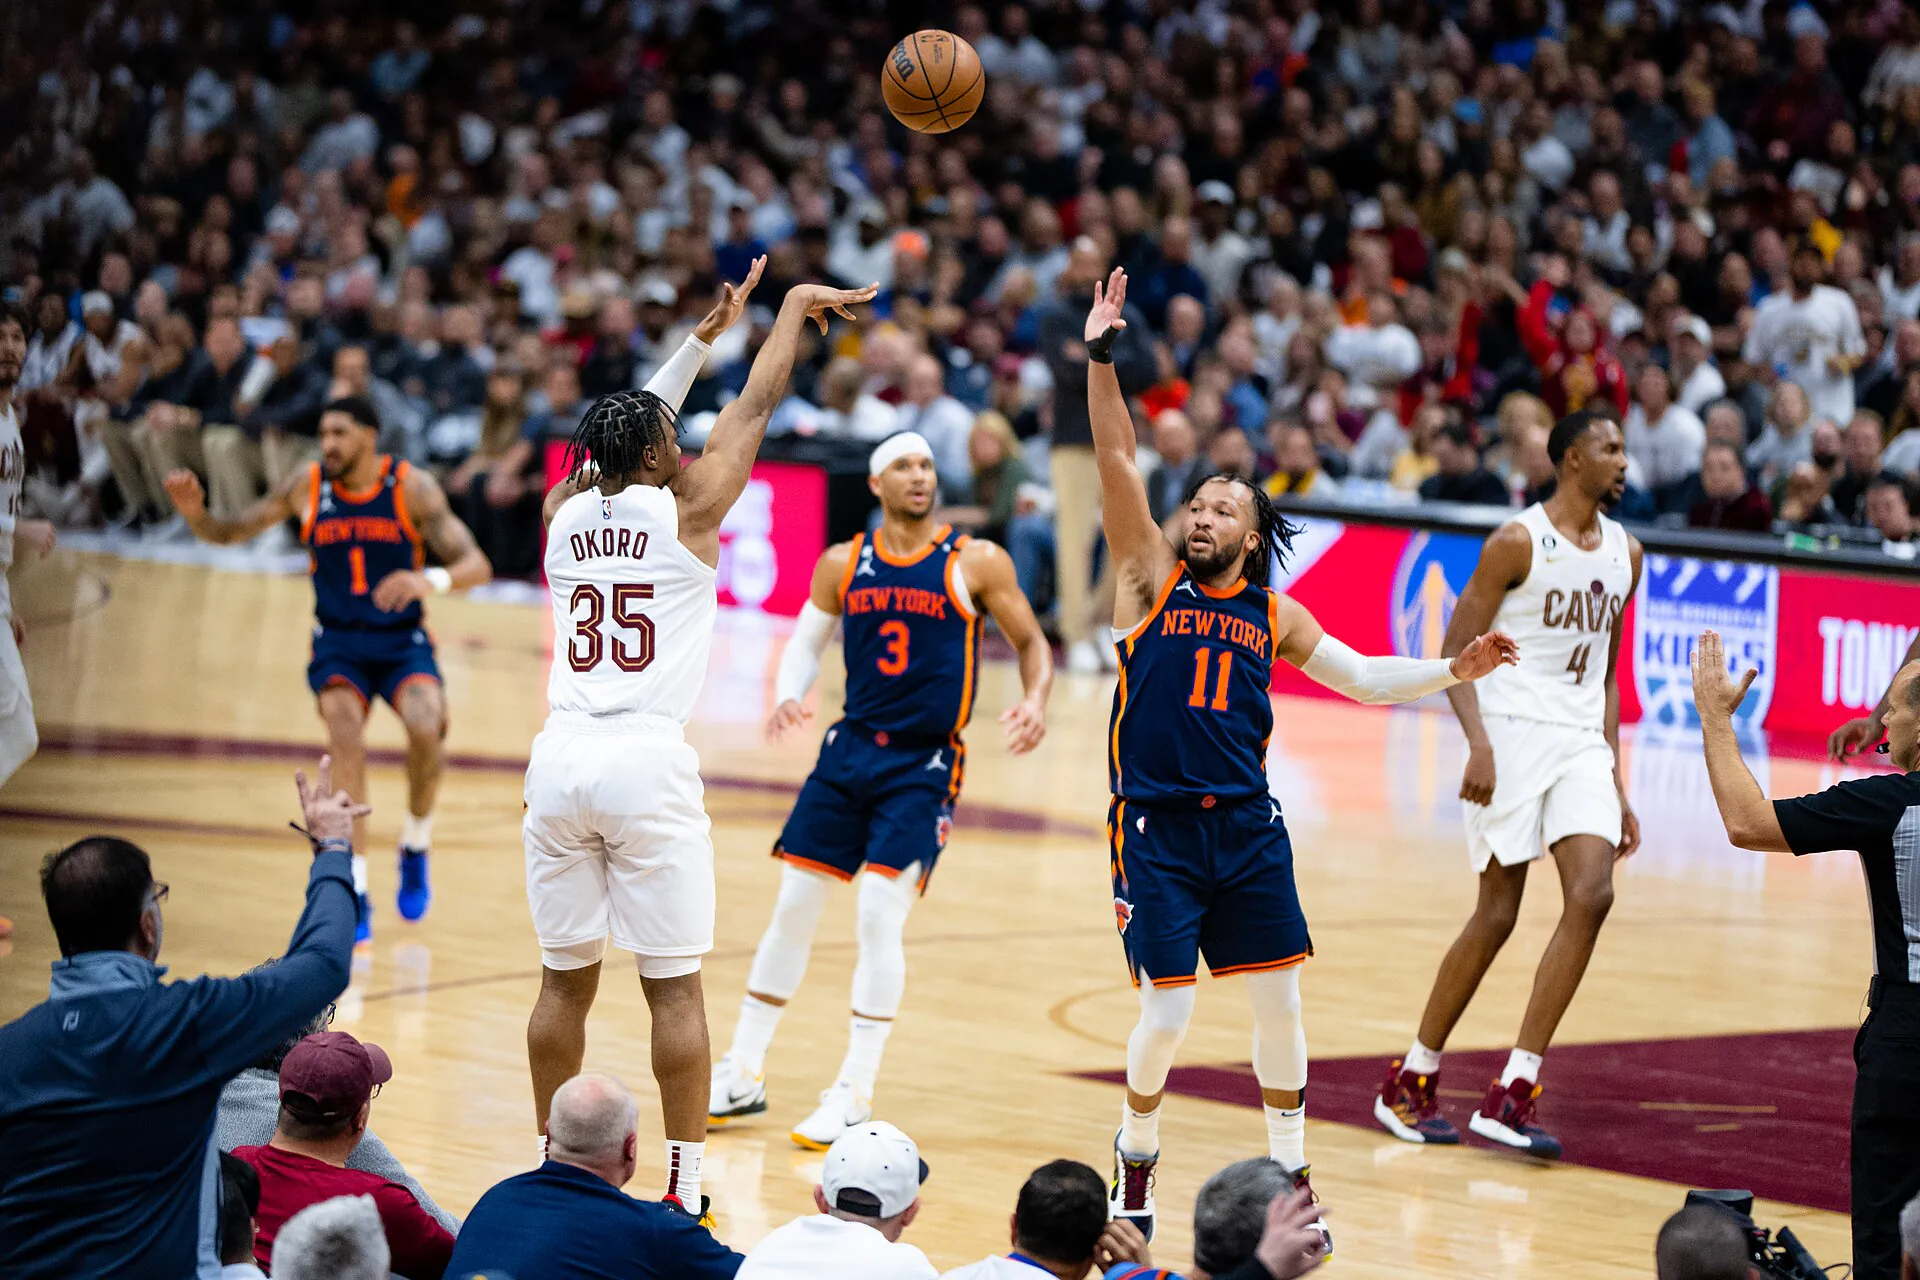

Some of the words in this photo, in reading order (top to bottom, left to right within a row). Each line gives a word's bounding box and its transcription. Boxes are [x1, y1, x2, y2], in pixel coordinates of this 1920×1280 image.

[570, 527, 649, 562] OKORO
[348, 546, 368, 596] 1
[568, 584, 655, 672] 35
[847, 587, 892, 616] NEW
[893, 587, 947, 620] YORK
[876, 620, 910, 675] 3
[1161, 609, 1216, 636] NEW
[1217, 612, 1269, 660] YORK
[1188, 647, 1233, 711] 11
[1566, 642, 1592, 686] 4
